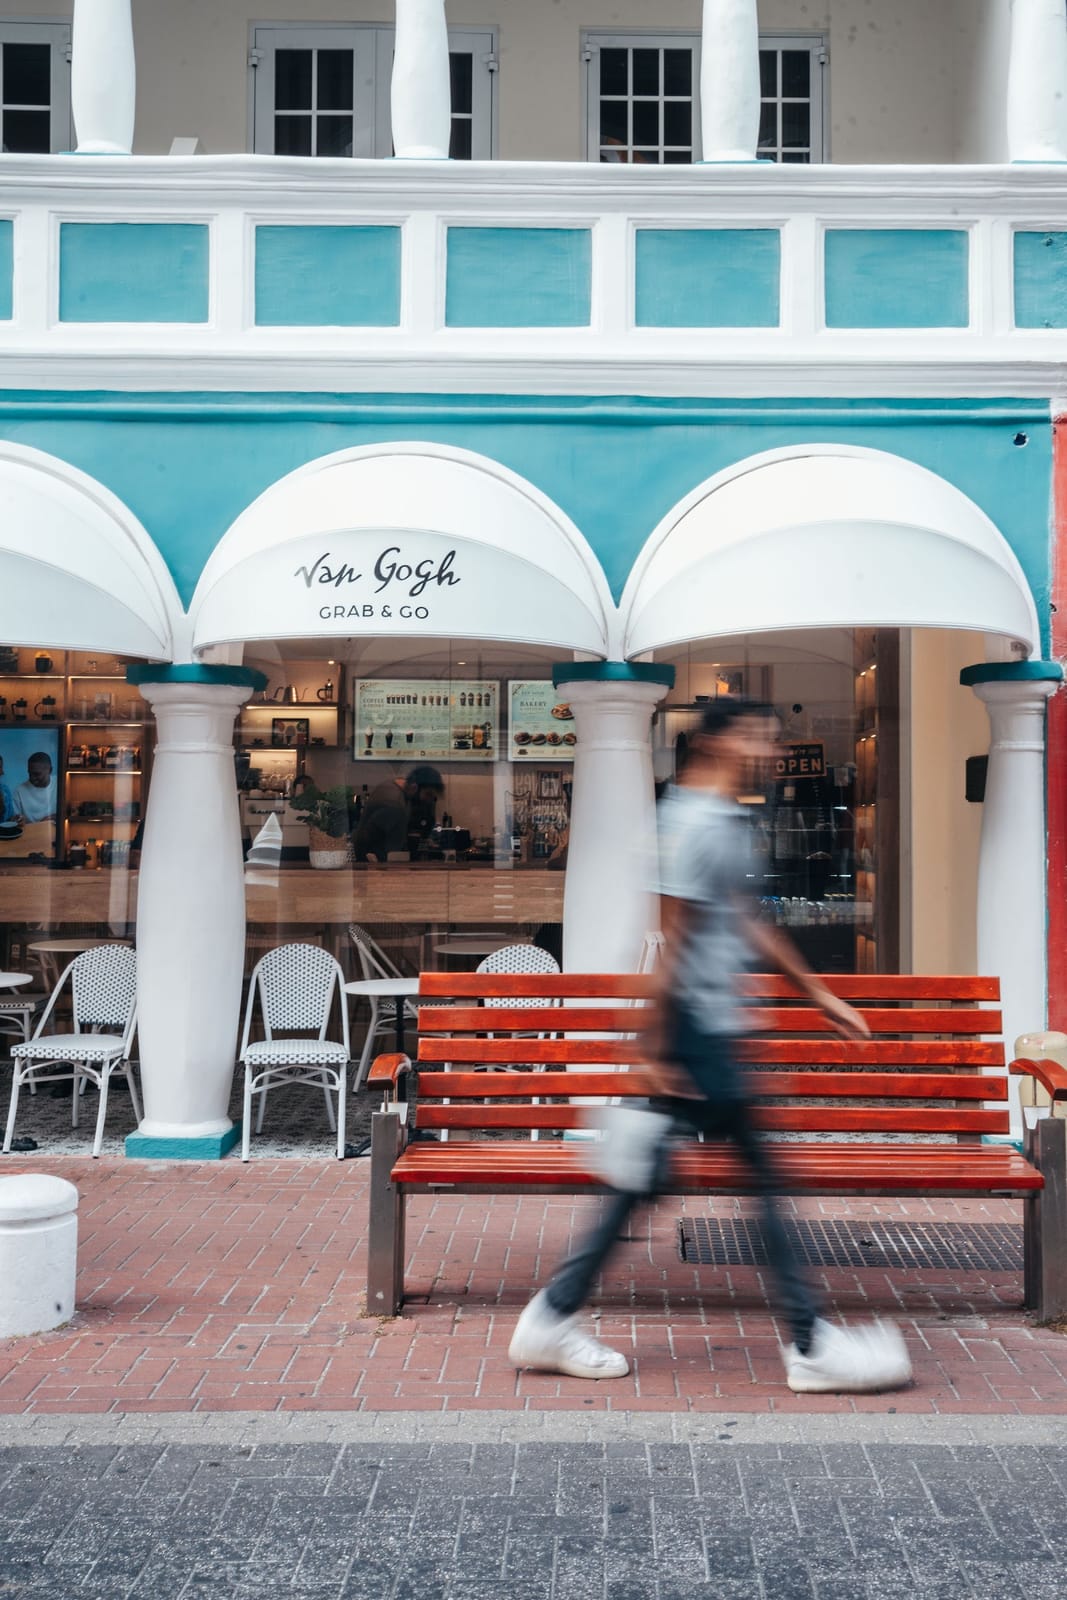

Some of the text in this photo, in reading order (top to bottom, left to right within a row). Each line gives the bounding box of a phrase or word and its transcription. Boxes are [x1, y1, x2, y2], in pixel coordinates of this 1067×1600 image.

[294, 547, 461, 597] Van Gogh
[319, 604, 429, 619] GRAB & GO
[775, 758, 822, 773] OPEN
